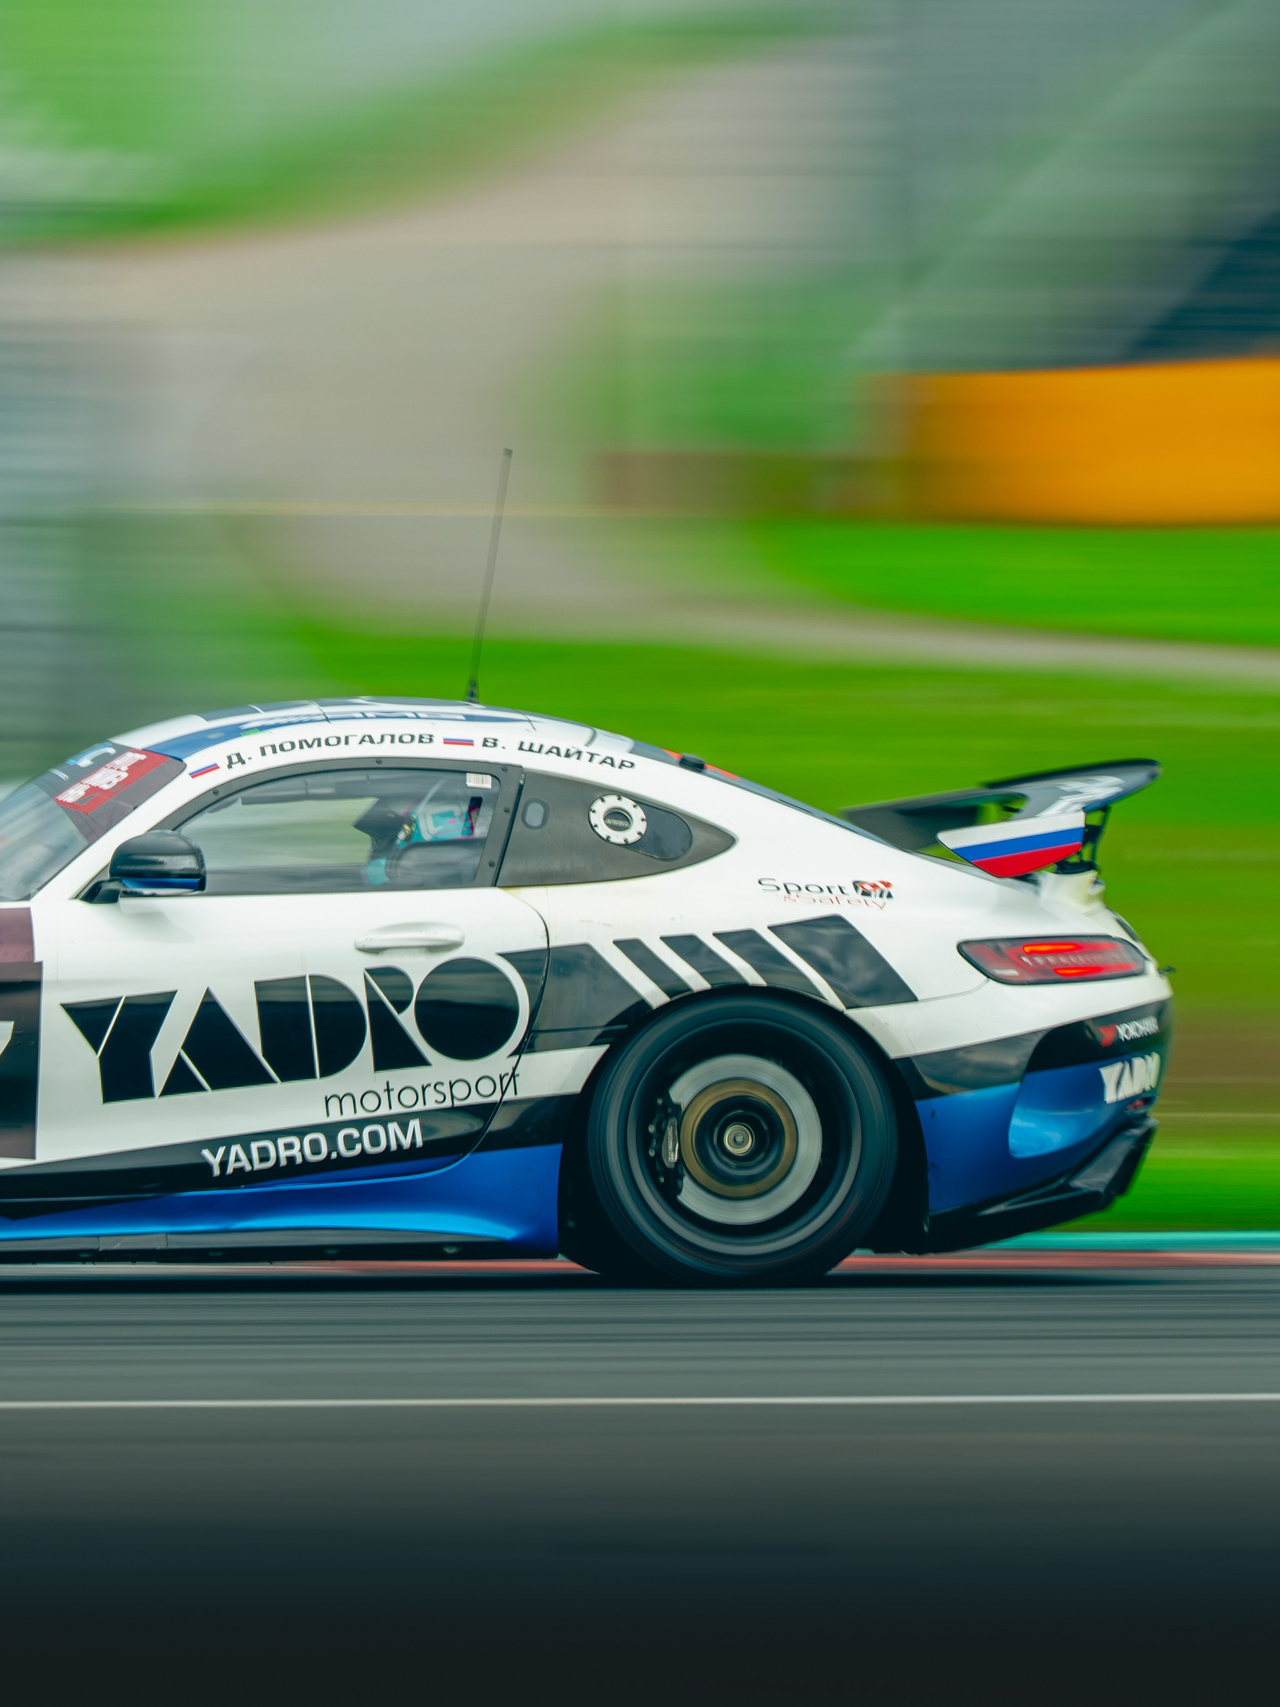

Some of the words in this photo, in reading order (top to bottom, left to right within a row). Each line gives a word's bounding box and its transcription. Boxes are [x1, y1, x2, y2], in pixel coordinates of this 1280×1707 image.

[225, 752, 253, 769] Д.
[260, 733, 435, 757] ПОМОГАЛОВ
[482, 737, 506, 750] В.
[518, 740, 636, 770] ШАЙТАР
[758, 877, 849, 896] Sport
[60, 957, 523, 1104] YADRO
[324, 1066, 521, 1118] motorsport
[200, 1117, 424, 1178] YADRO.COM
